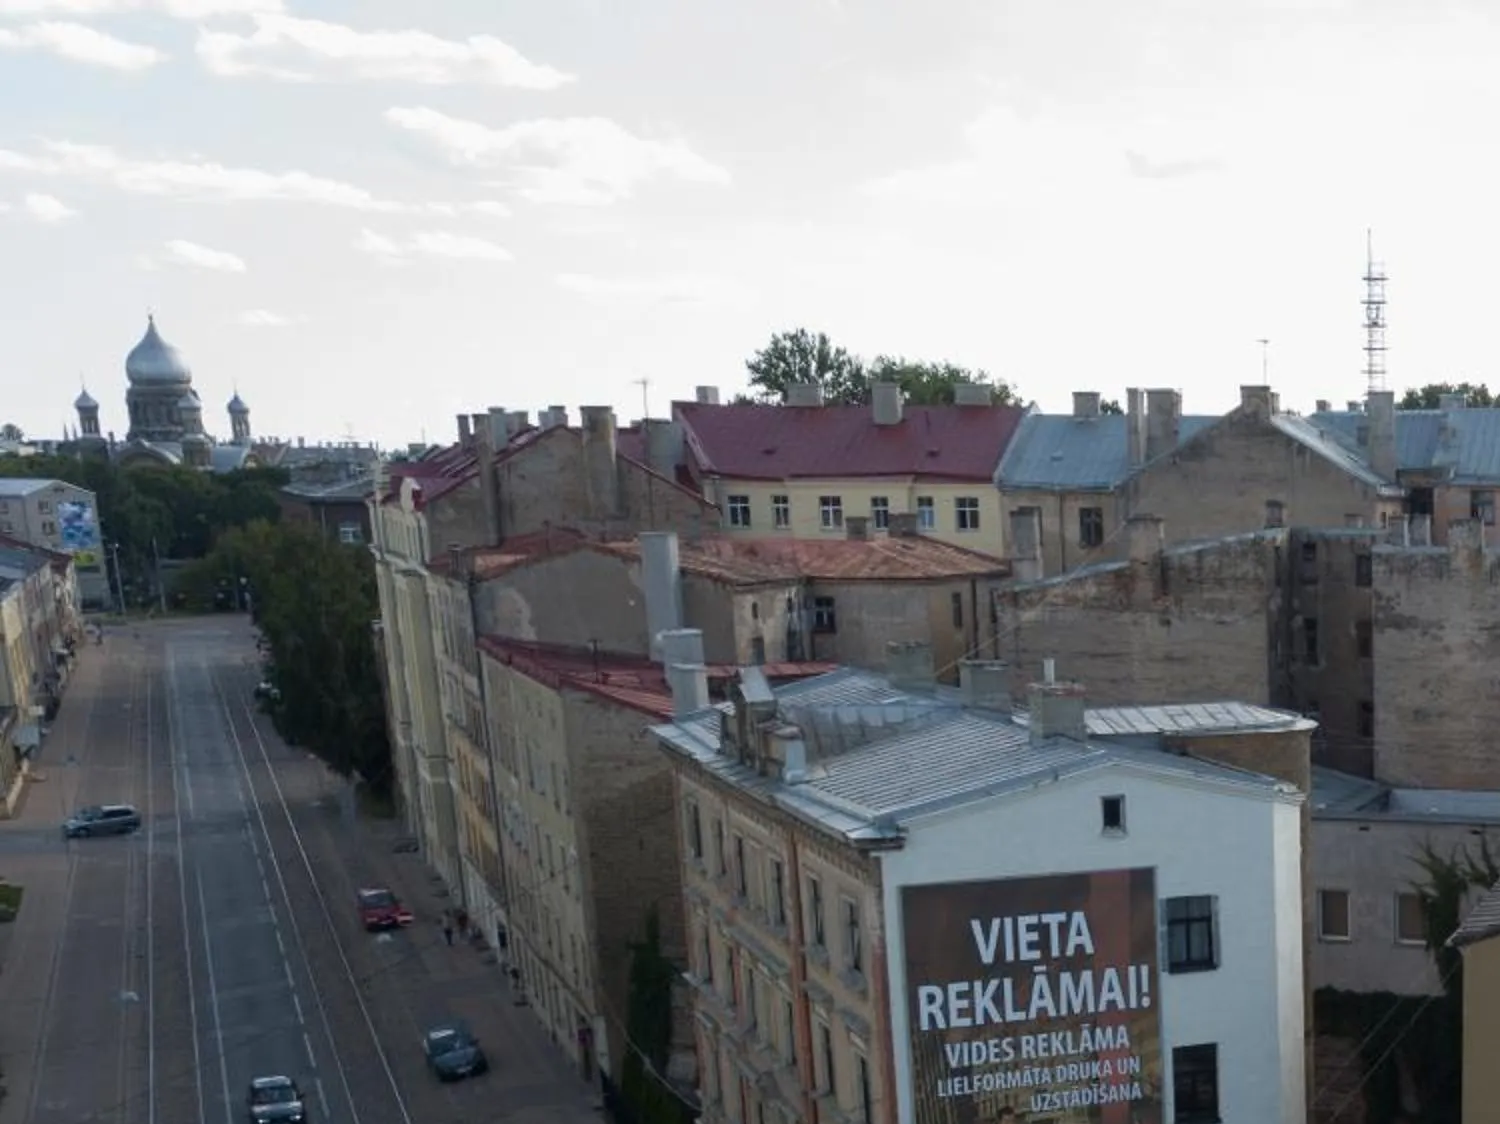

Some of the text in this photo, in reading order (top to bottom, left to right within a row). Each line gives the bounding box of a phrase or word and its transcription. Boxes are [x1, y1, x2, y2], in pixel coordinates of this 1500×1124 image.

[970, 910, 1095, 965] VIETA
[918, 964, 1151, 1031] REKLĀMAI!
[944, 1024, 1130, 1068] VIDES REKLĀMA
[937, 1056, 1141, 1097] LIELFORMĀTA DRUKA UN
